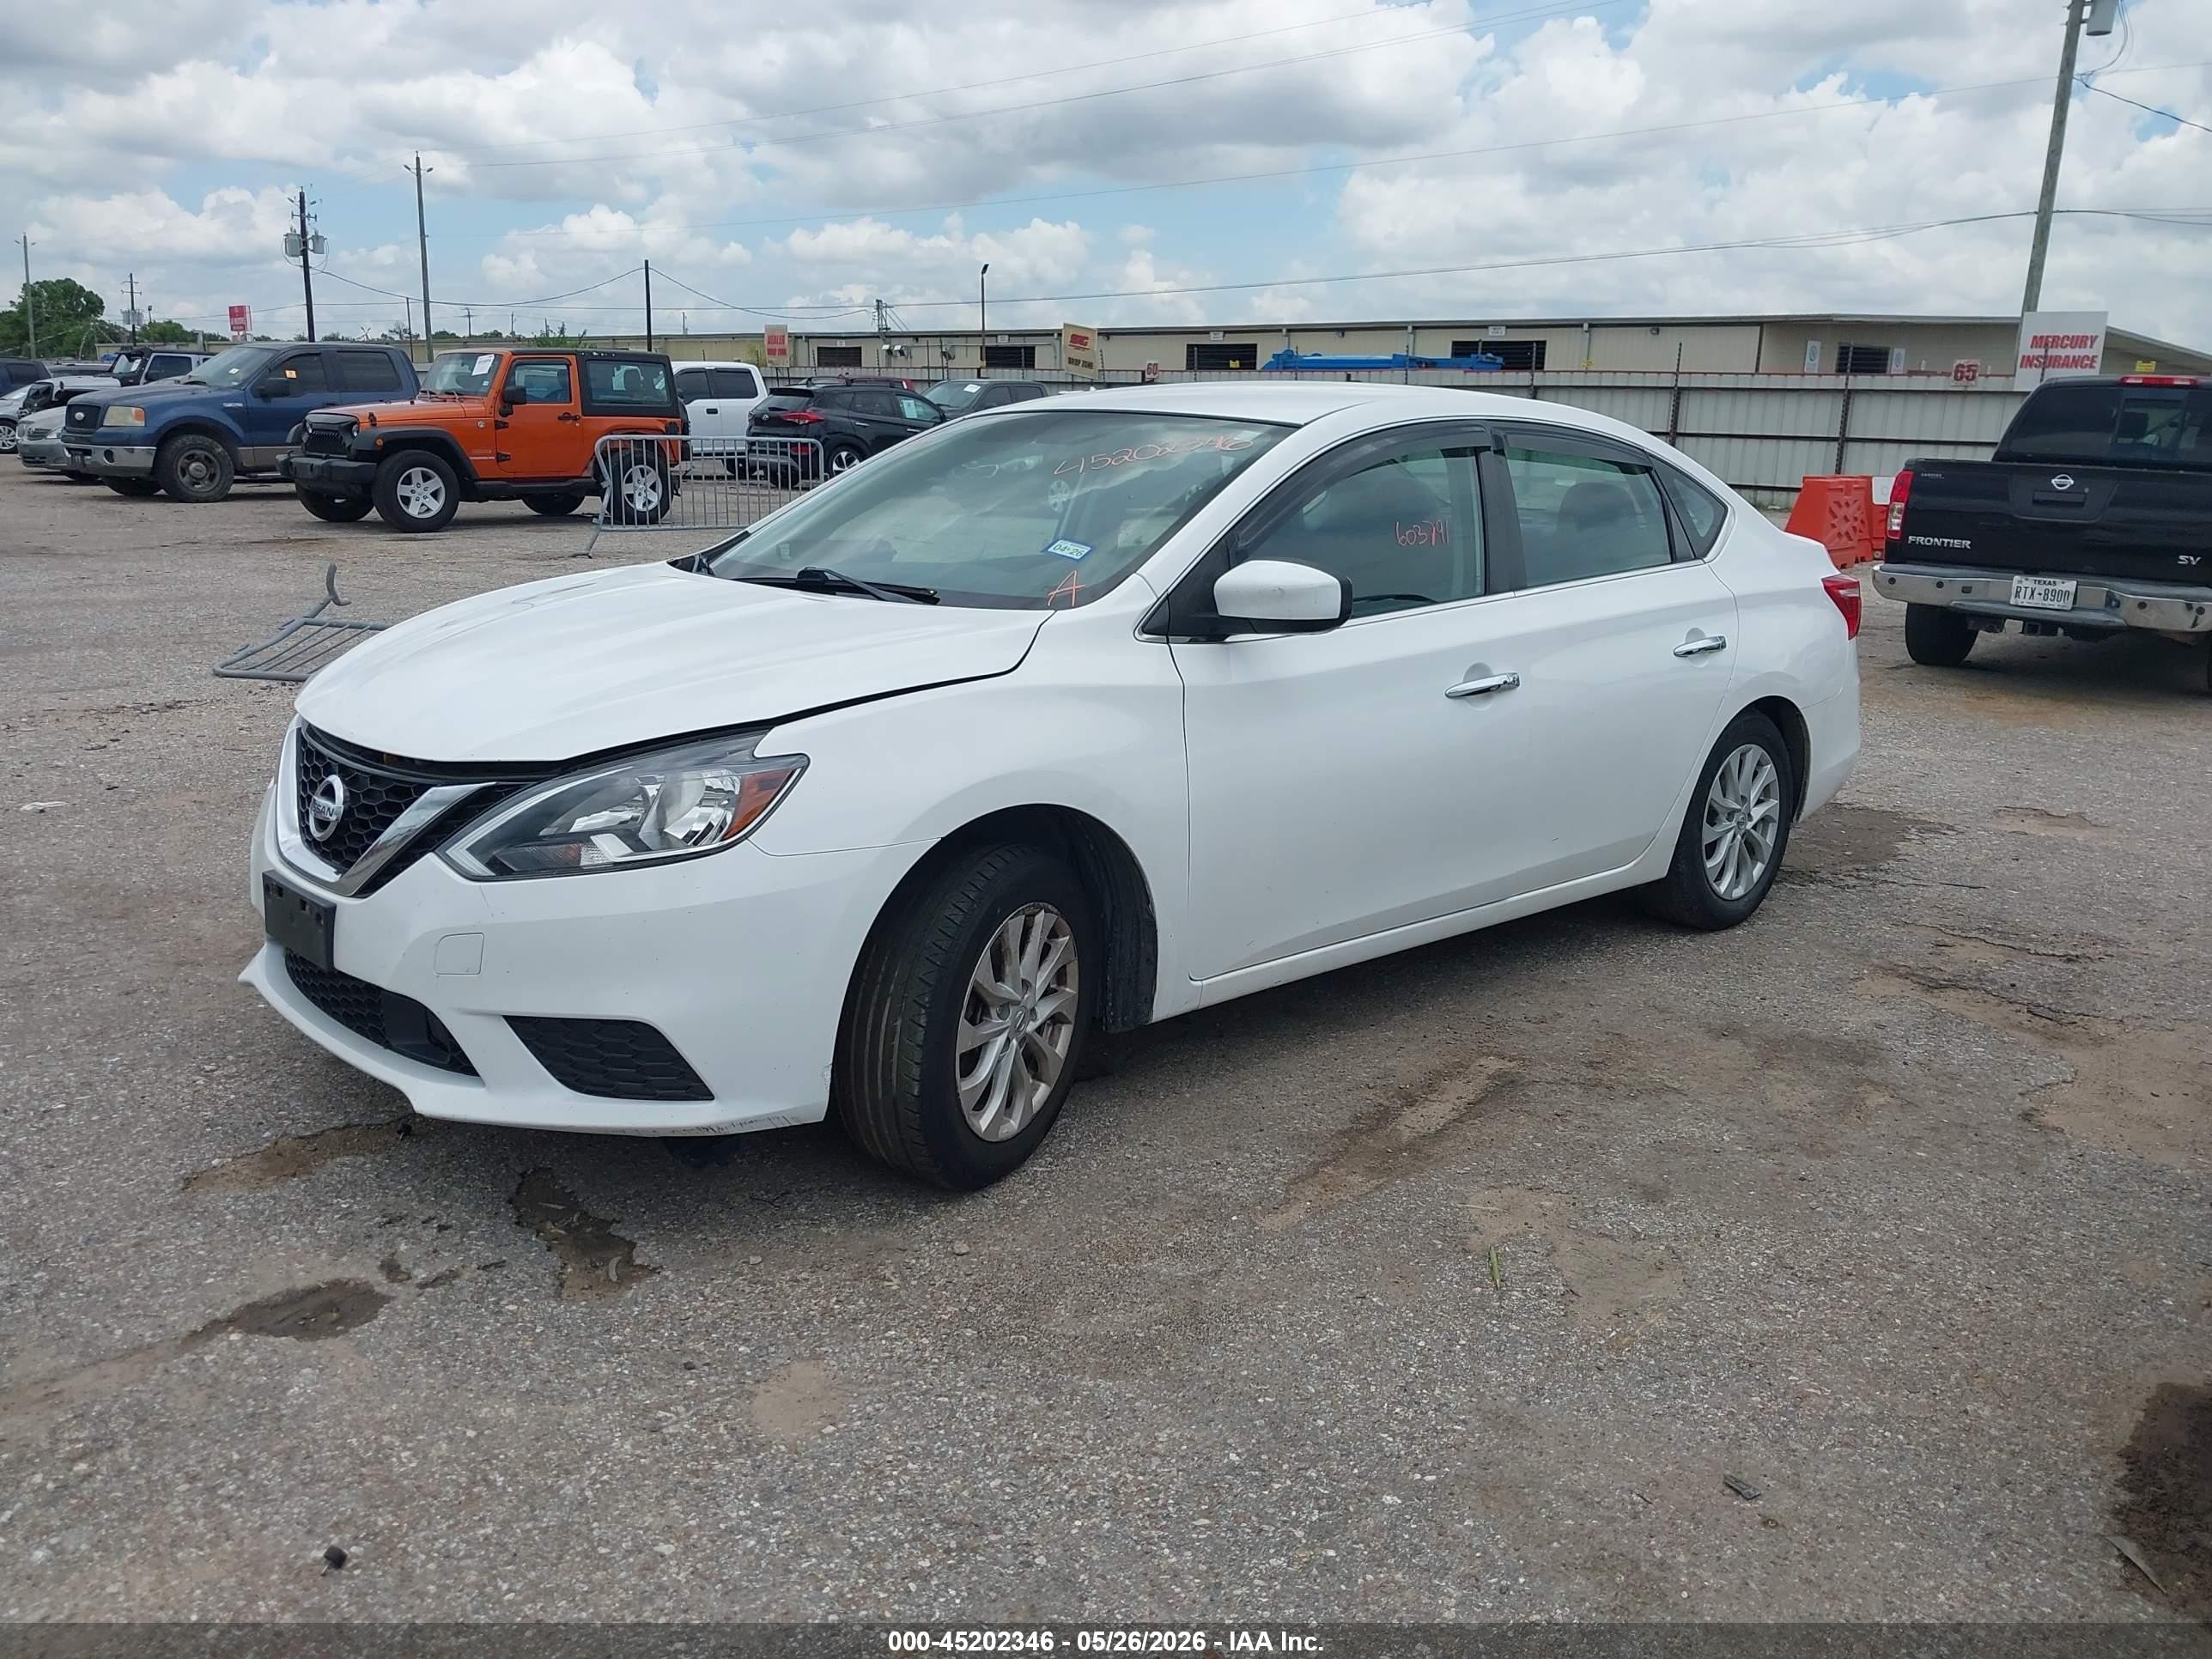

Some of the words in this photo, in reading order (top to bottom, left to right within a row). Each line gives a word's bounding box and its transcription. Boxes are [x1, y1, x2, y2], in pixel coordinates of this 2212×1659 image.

[2030, 335, 2099, 349] MERCURY
[1146, 362, 1158, 375] 60
[2020, 355, 2099, 369] INSURANCE
[1953, 363, 1978, 381] 65
[1907, 535, 1972, 550] FRONTIER
[2177, 555, 2203, 565] SV
[1048, 570, 1085, 606] A
[311, 799, 335, 817] SSAN
